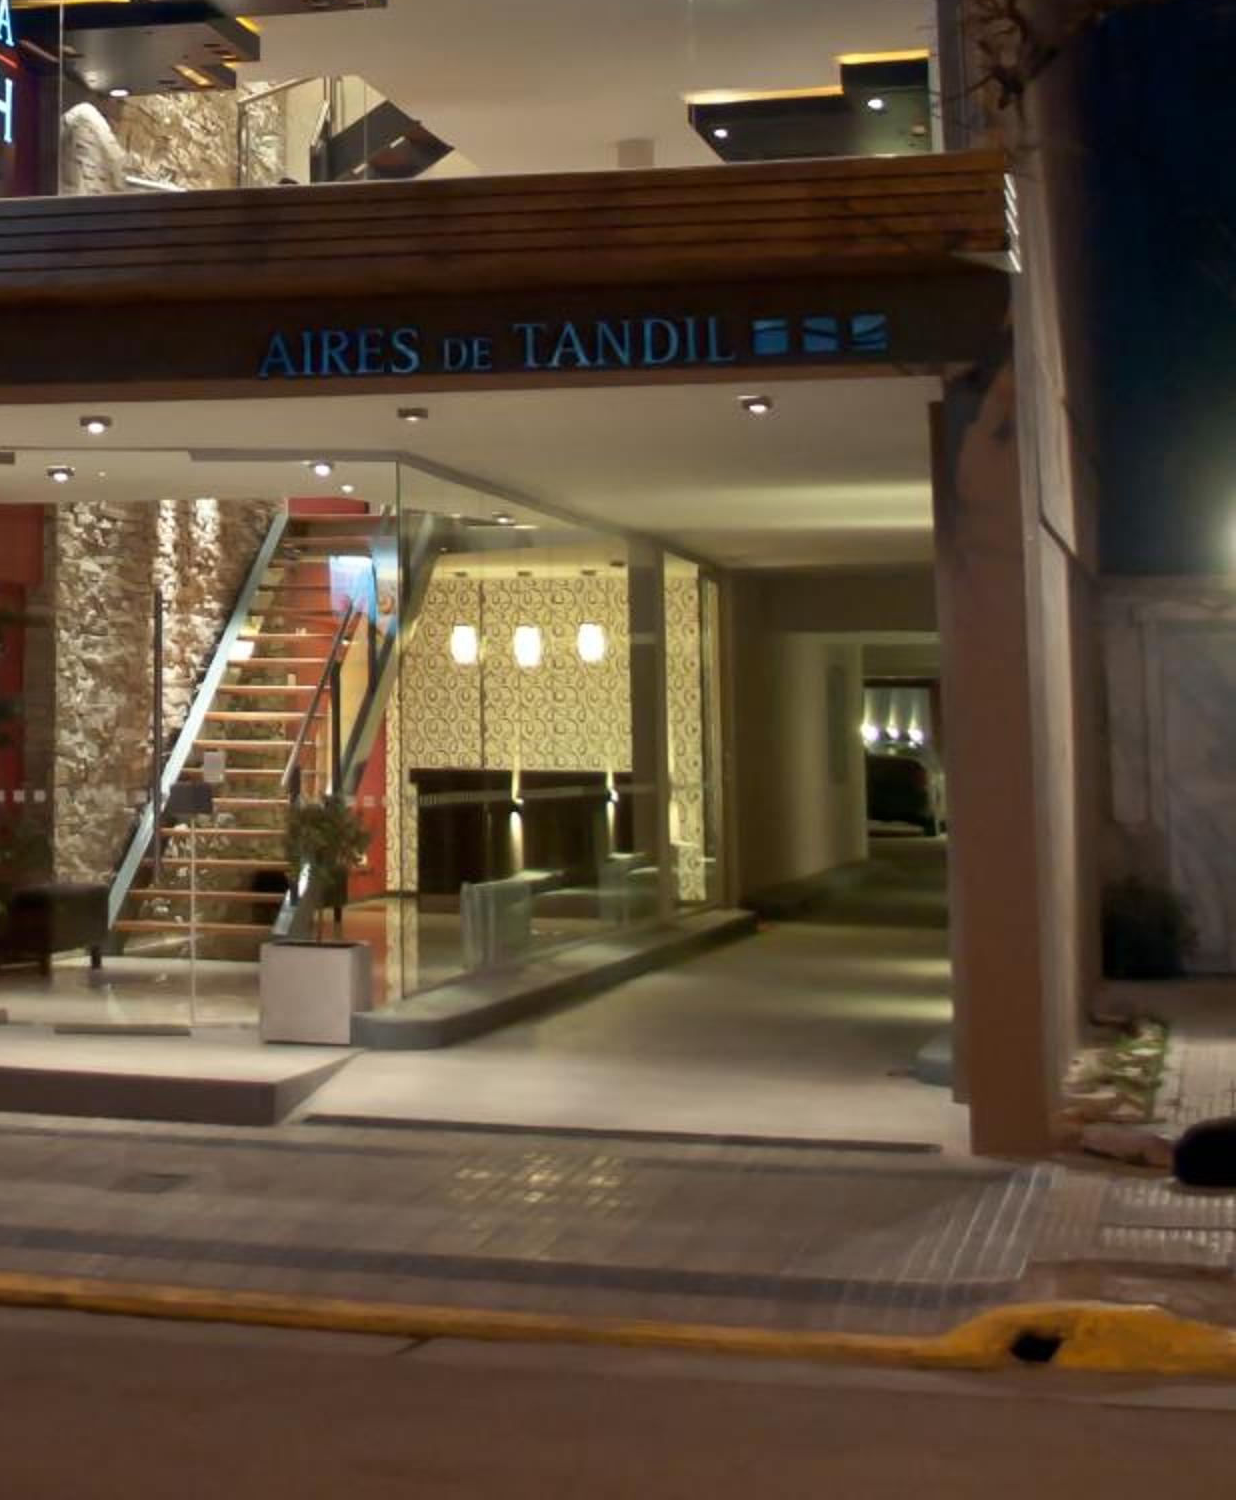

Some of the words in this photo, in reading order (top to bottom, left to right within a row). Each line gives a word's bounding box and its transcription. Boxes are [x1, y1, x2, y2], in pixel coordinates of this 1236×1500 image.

[258, 325, 421, 379] AIRES
[442, 336, 493, 371] DE
[513, 315, 735, 368] TANDIL
